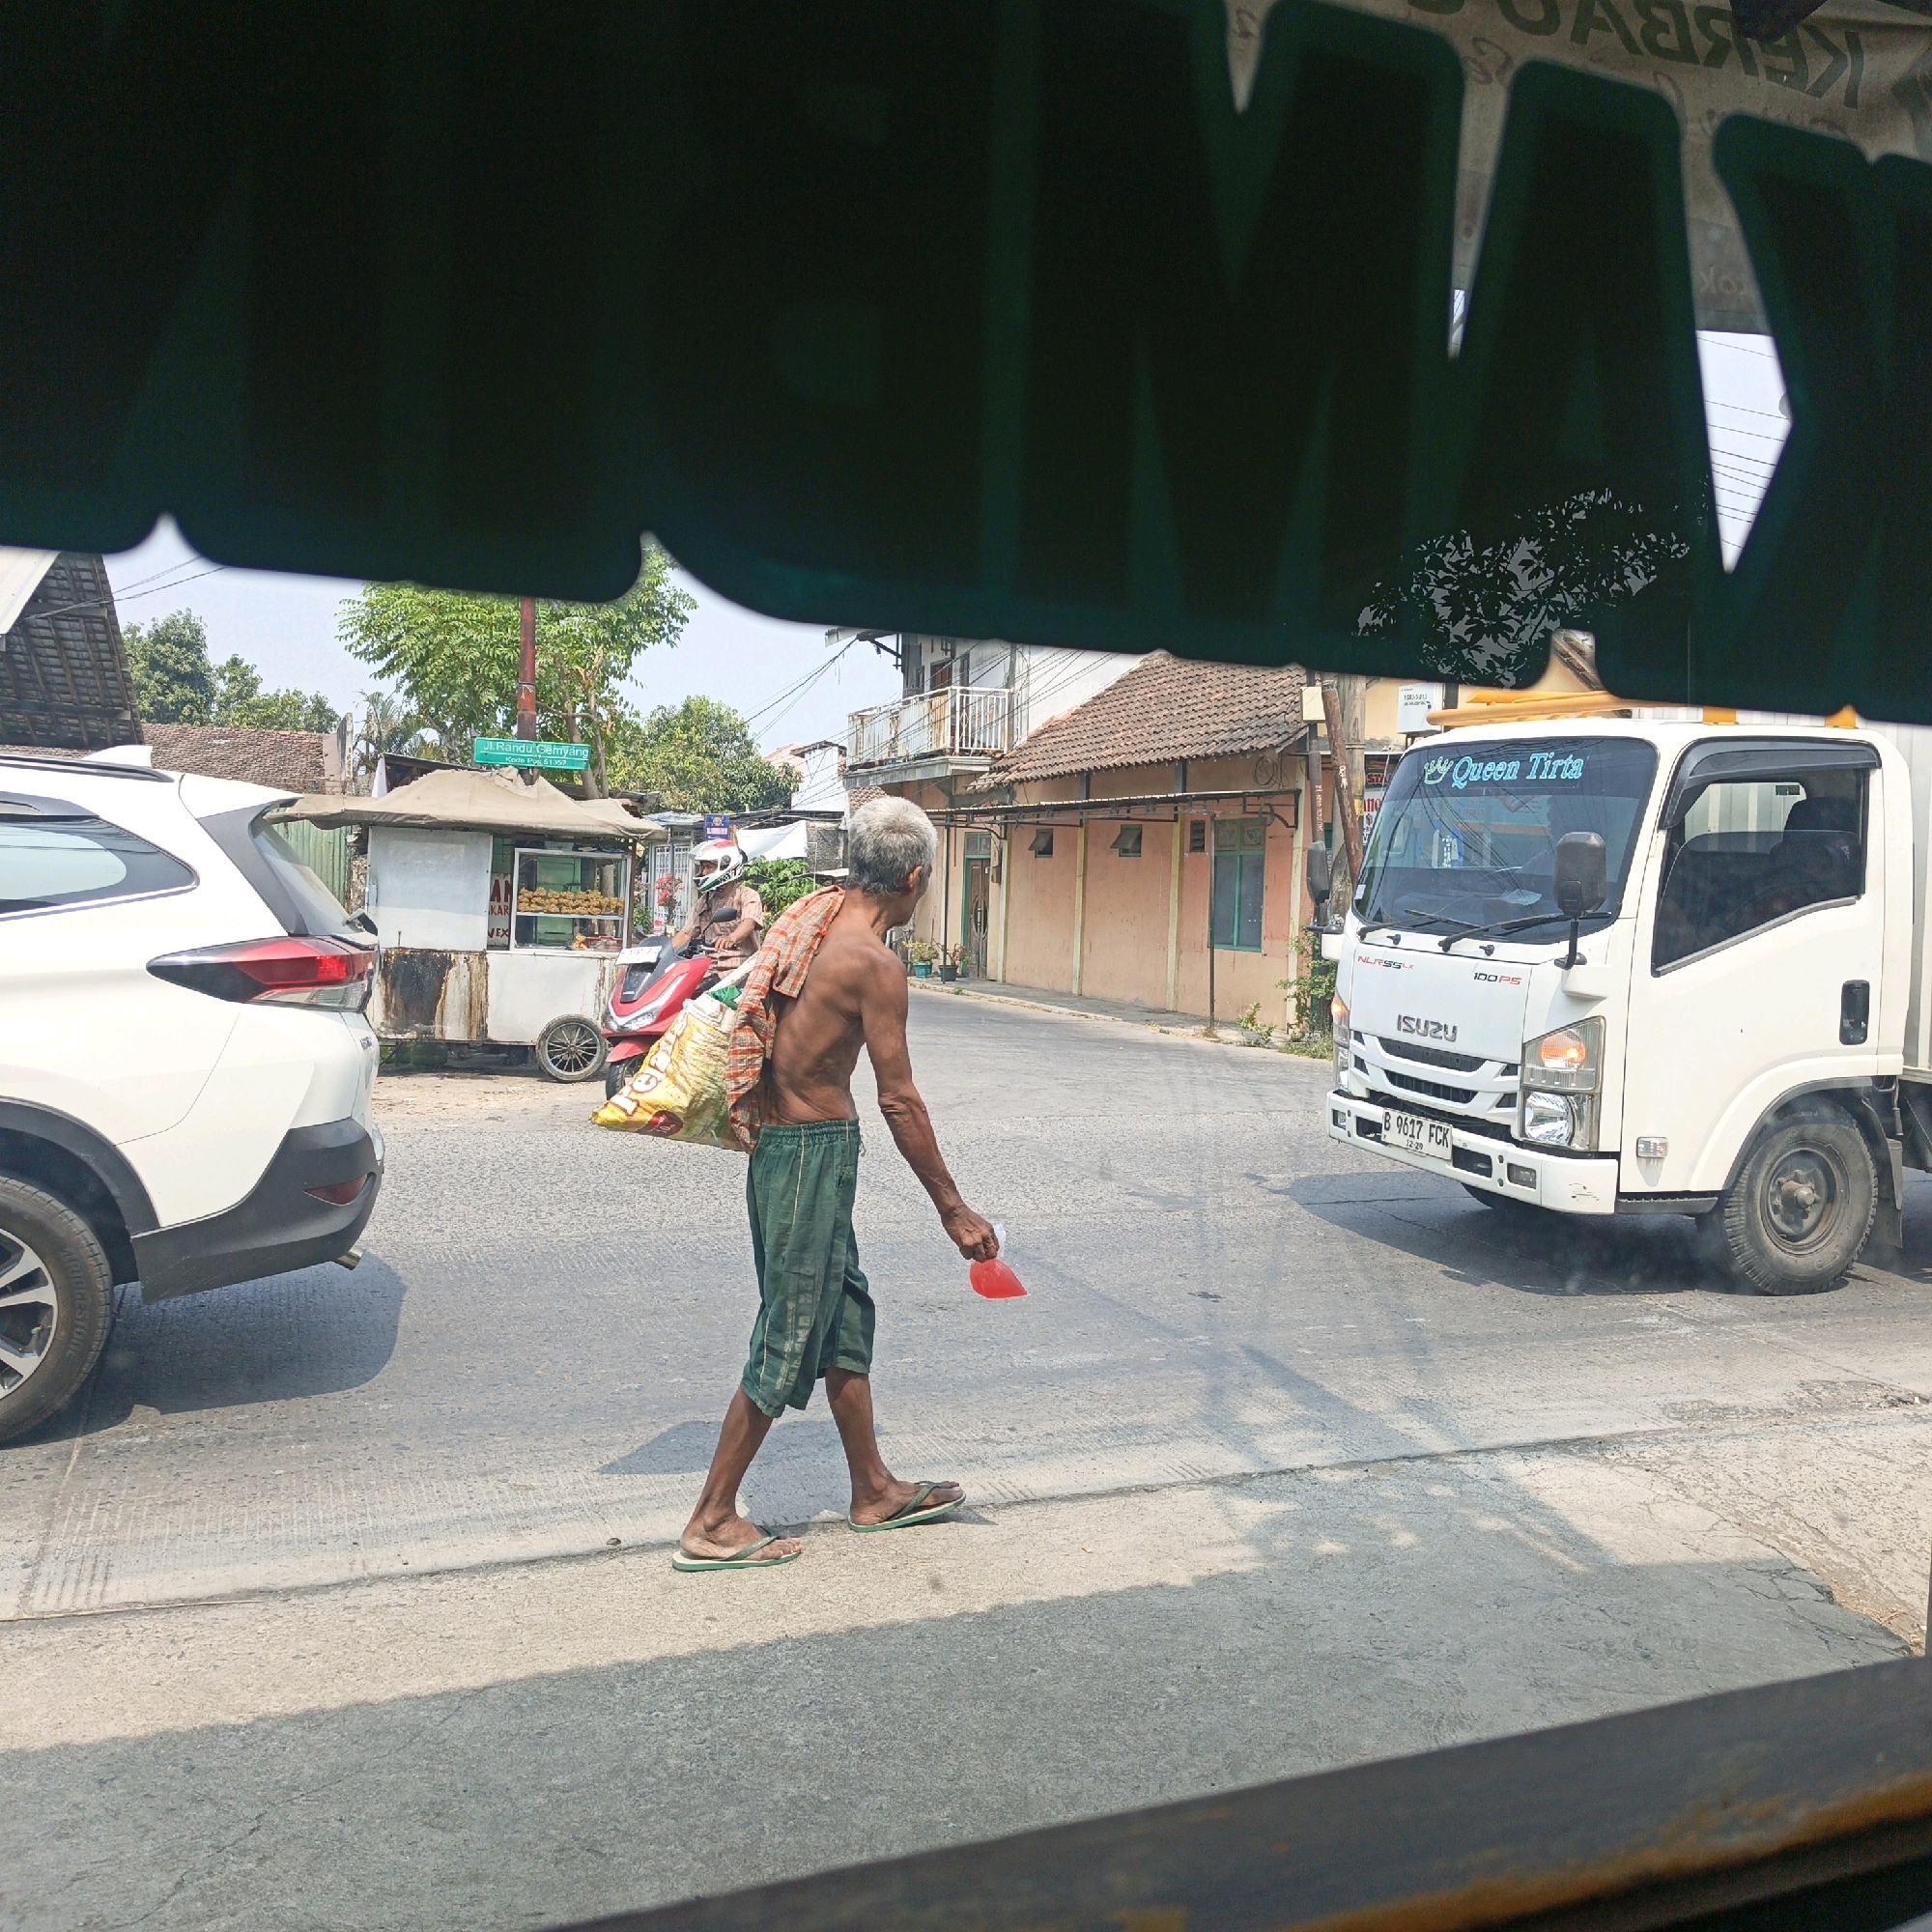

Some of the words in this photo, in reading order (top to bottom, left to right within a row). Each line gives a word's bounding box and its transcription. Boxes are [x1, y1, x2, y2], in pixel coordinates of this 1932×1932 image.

[1452, 756, 1520, 789] Queen
[1526, 752, 1584, 781] Tirta
[1397, 1014, 1459, 1042] ISUZU
[1383, 1111, 1391, 1131] B
[1396, 1115, 1424, 1140] 9617
[1429, 1123, 1450, 1149] FCK
